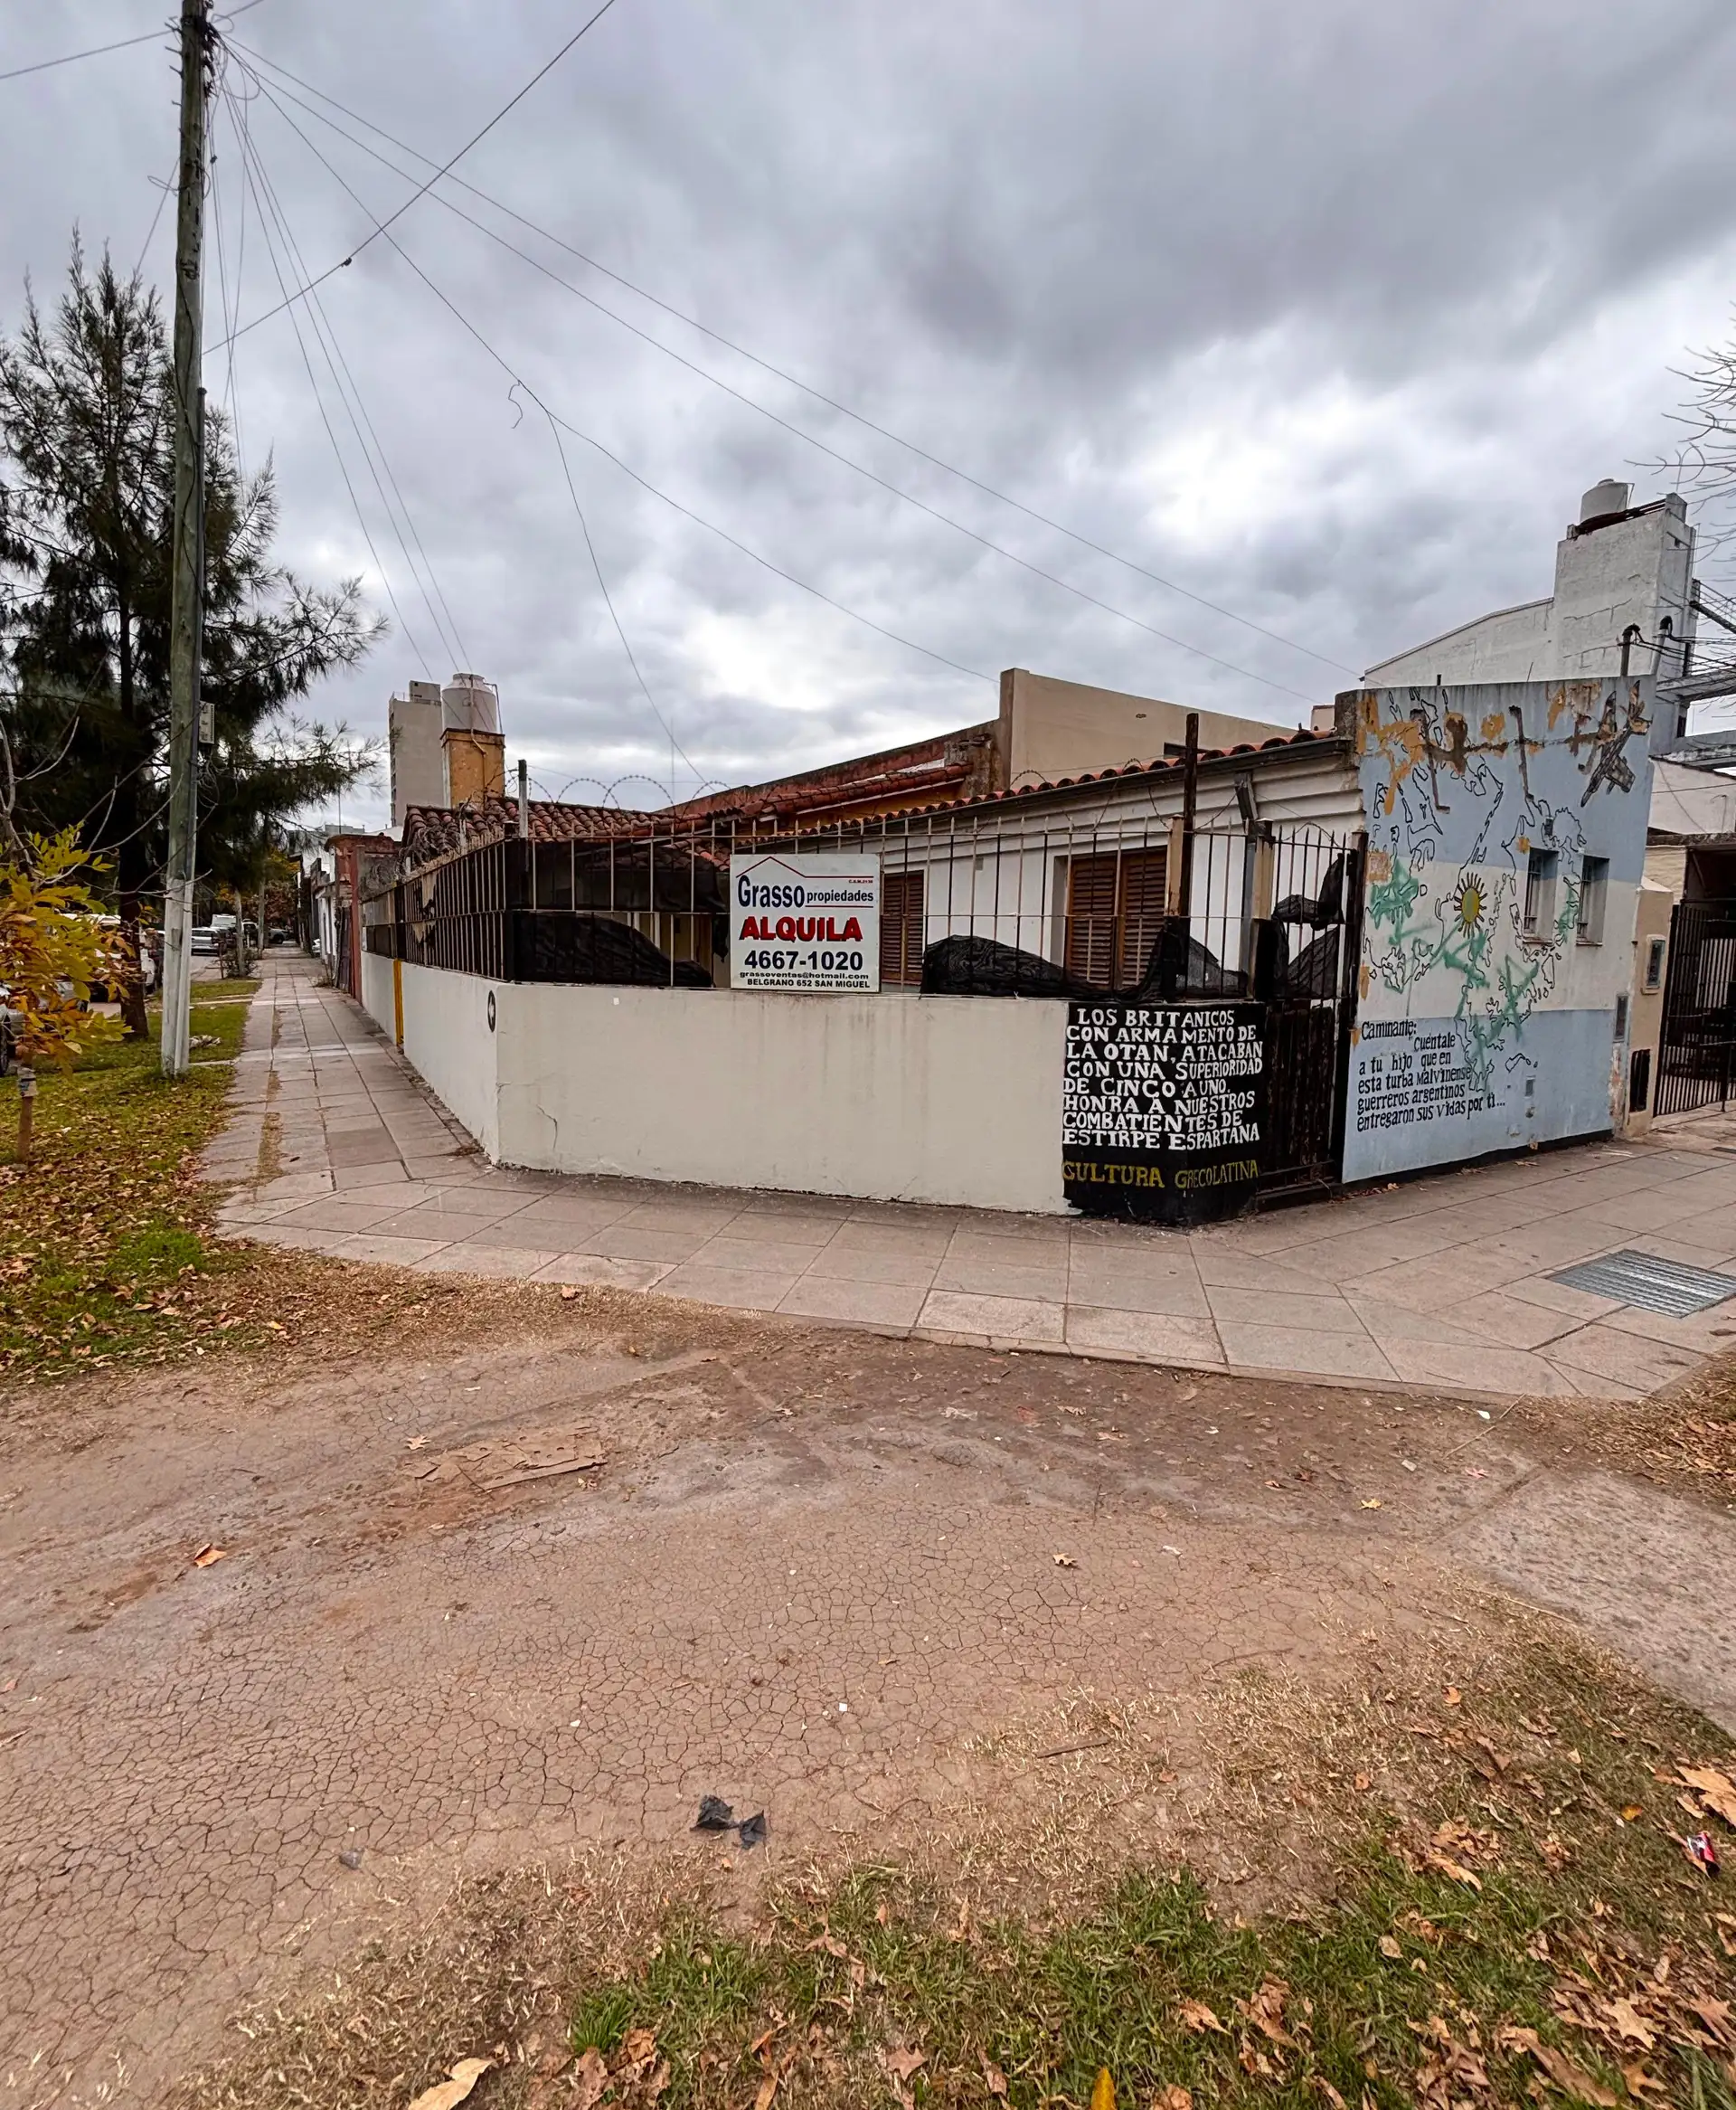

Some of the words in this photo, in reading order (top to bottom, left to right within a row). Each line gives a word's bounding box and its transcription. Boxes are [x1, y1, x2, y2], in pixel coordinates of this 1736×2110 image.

[738, 875, 805, 908] Grasso
[807, 889, 873, 904] propiedades
[739, 916, 863, 942] ALQUILA
[744, 951, 863, 970] 4667-1020
[815, 979, 833, 988] SAN
[1077, 1008, 1118, 1025] LOS
[1125, 1010, 1234, 1027] BRITANICOS
[1067, 1027, 1109, 1042] CON
[1116, 1027, 1234, 1044] ARMAMENTO
[1238, 1025, 1257, 1041] DE
[1362, 1019, 1417, 1040] Caminante:
[1067, 1043, 1098, 1059] LA
[1104, 1046, 1175, 1063] OTAN,
[1182, 1041, 1263, 1062] ATACABAN
[1067, 1062, 1109, 1077] CON
[1118, 1062, 1166, 1080] UNA
[1175, 1058, 1263, 1080] SUPERIORIDAD
[1359, 1061, 1365, 1075] a
[1371, 1055, 1382, 1074] tu
[1392, 1053, 1412, 1073] hijo
[1421, 1055, 1438, 1071] que
[1439, 1052, 1451, 1064] en
[1064, 1078, 1090, 1093] DE
[1101, 1078, 1175, 1097] CINCO
[1183, 1083, 1197, 1098] A
[1200, 1080, 1231, 1095] UNO.
[1358, 1078, 1382, 1094] esta
[1385, 1070, 1413, 1090] turba
[1064, 1095, 1139, 1112] HONRA
[1148, 1097, 1165, 1114] A
[1175, 1091, 1255, 1116] NUESTROS
[1358, 1091, 1409, 1115] guerreros
[1412, 1083, 1465, 1104] argentinos
[1063, 1112, 1217, 1132] COMBATIENTES
[1222, 1111, 1242, 1127] DE
[1357, 1109, 1414, 1132] entregaron
[1418, 1106, 1433, 1121] sus
[1437, 1101, 1466, 1118] vidas
[1467, 1096, 1483, 1120] por
[1063, 1130, 1160, 1149] ESTIRPE
[1168, 1123, 1260, 1150] ESPARTANA
[1175, 1160, 1259, 1188] GRECOLATINA
